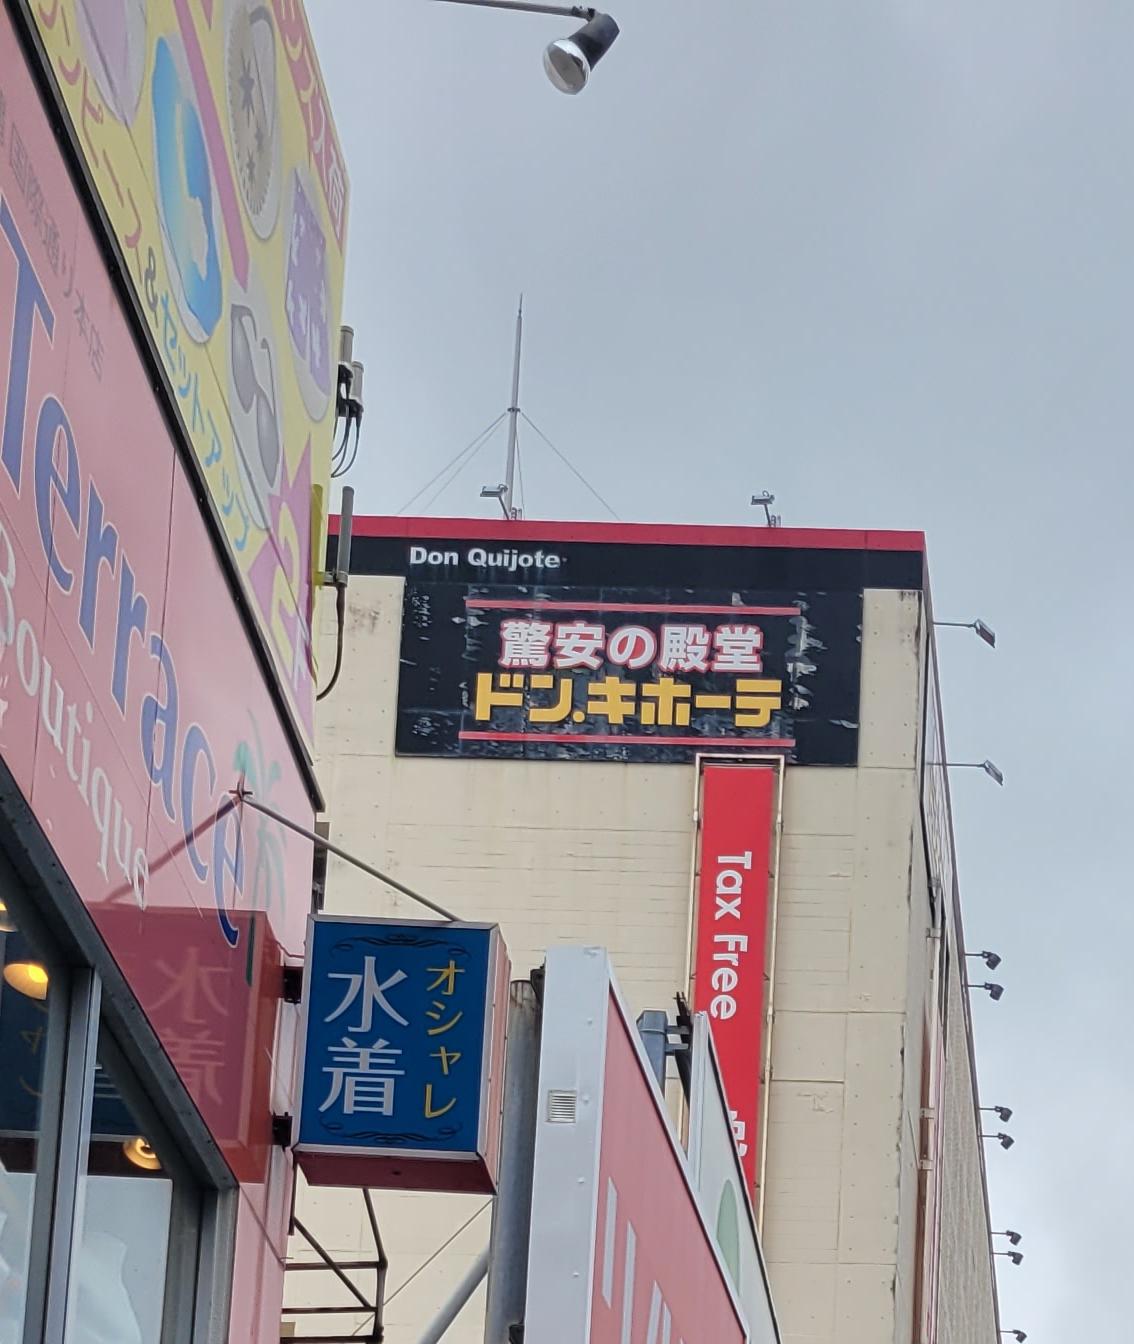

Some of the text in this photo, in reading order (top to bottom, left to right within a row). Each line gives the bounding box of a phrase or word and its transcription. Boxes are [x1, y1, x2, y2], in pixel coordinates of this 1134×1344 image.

[0, 190, 245, 948] Terrace
[409, 547, 561, 572] Don Quijote
[500, 620, 764, 674] 驚安の殿堂
[709, 850, 752, 1021] Tax Free
[318, 955, 409, 1117] 水着
[424, 958, 467, 1120] オシャレ
